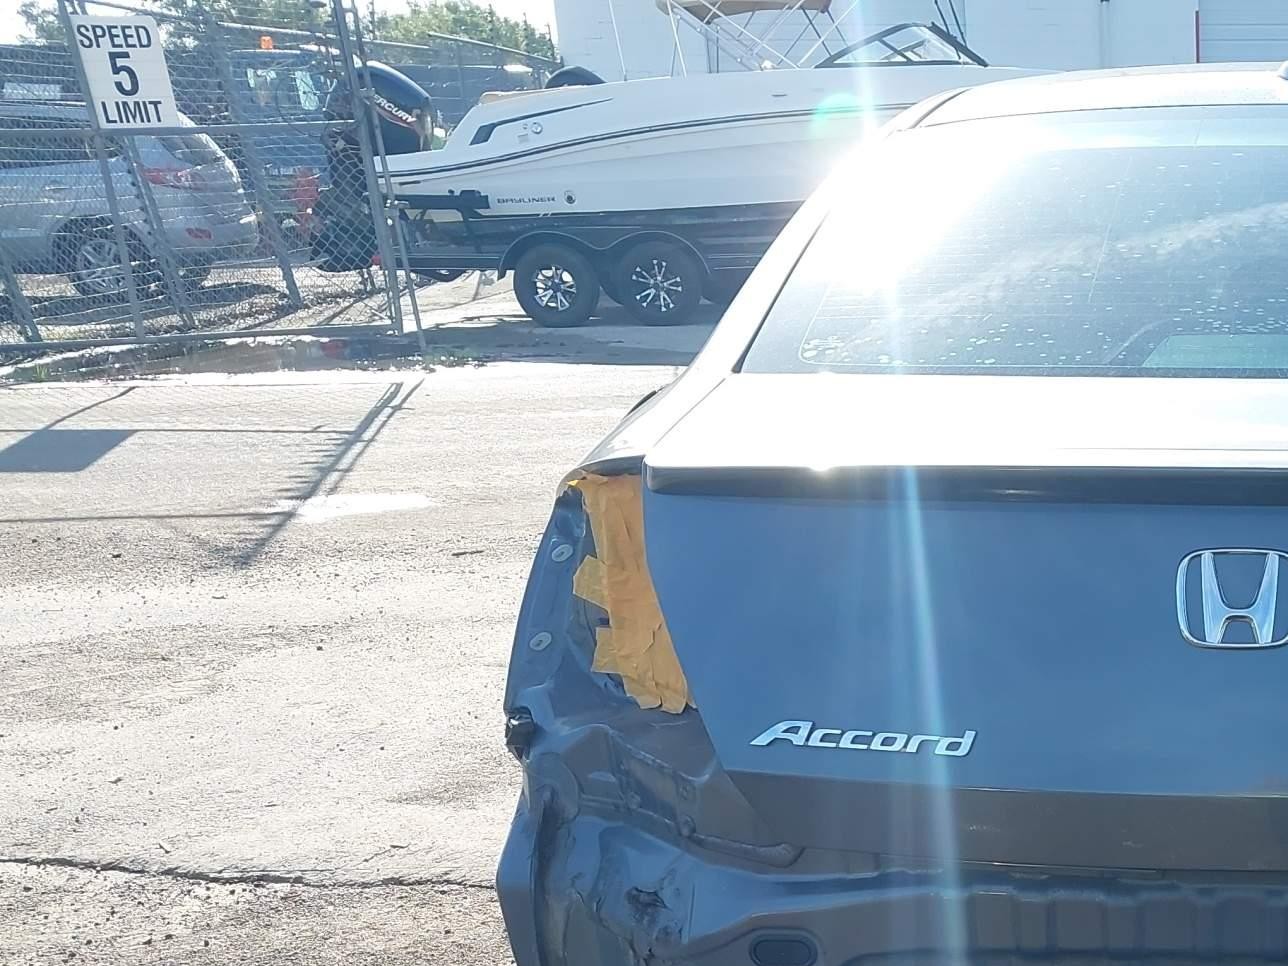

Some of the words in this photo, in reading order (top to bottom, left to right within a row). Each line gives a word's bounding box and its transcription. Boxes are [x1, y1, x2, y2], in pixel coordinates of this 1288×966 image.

[76, 24, 152, 49] SPEED
[108, 51, 139, 96] 5
[101, 100, 163, 124] LIMIT
[373, 93, 418, 123] ERCURY
[750, 719, 977, 757] Accord
